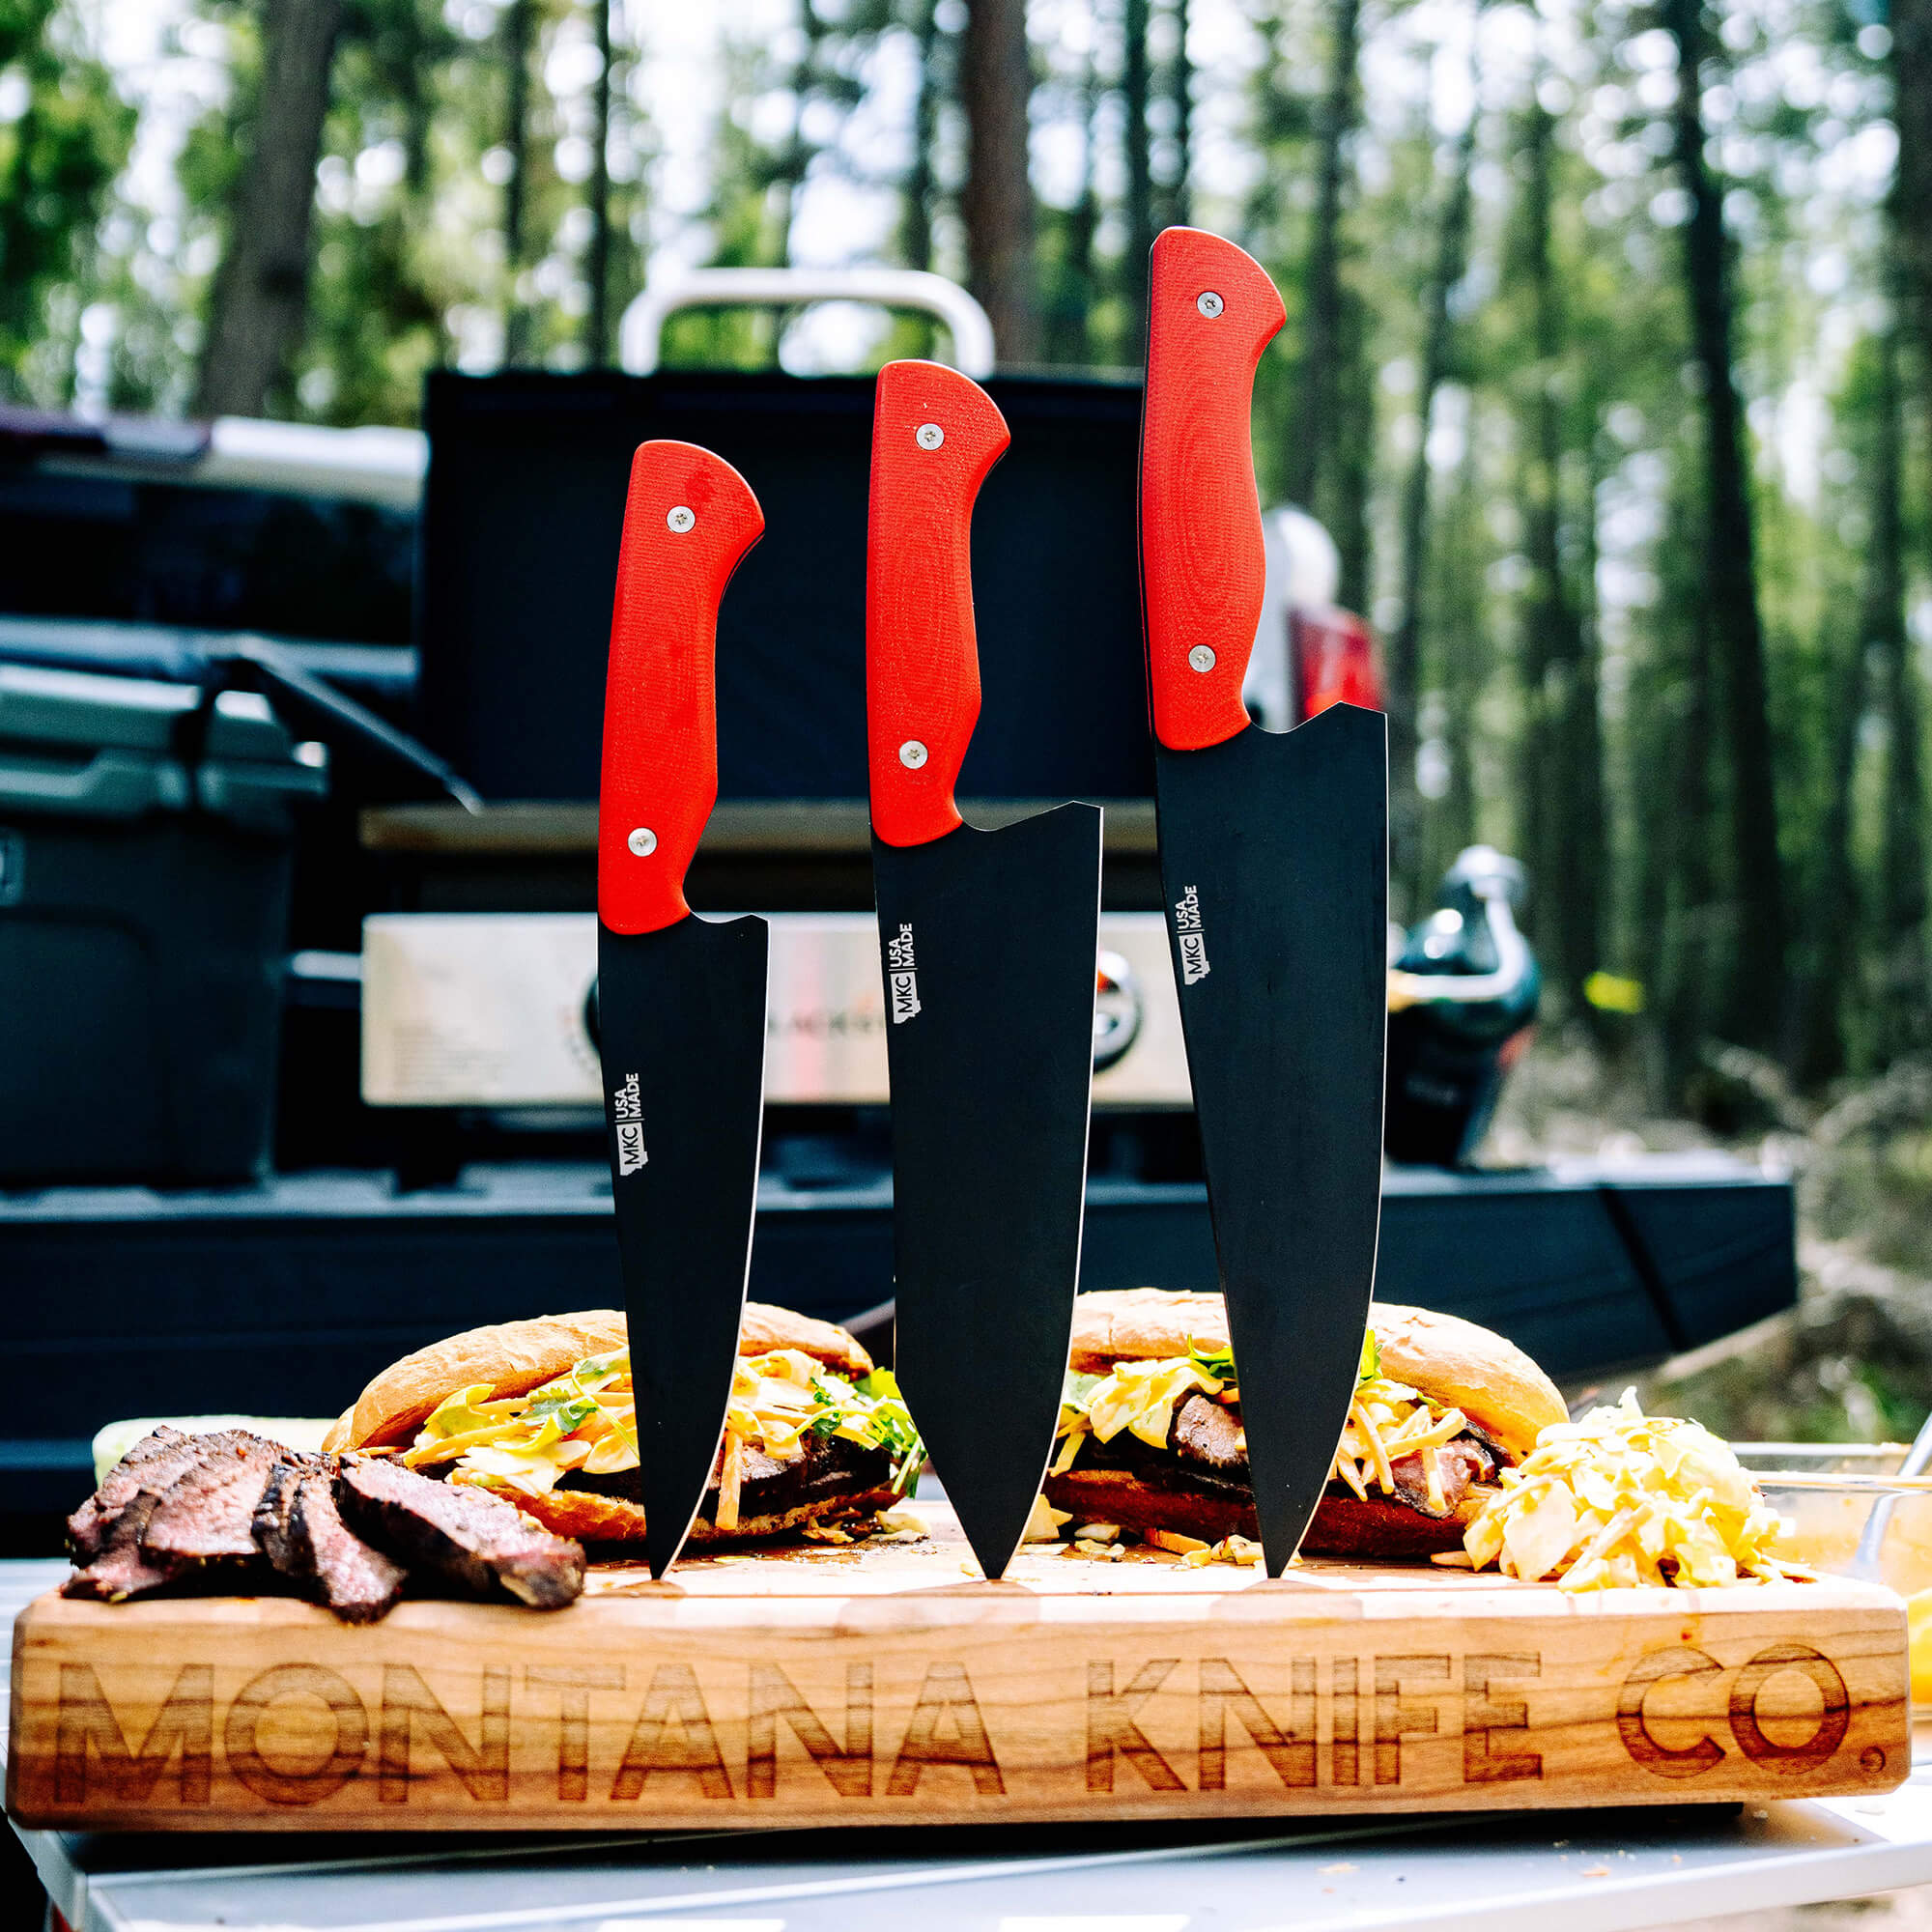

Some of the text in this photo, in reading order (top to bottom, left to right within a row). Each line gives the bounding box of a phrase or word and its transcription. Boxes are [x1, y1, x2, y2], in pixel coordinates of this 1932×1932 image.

[1175, 899, 1190, 929] USA
[1184, 885, 1202, 928] MADE
[889, 937, 903, 967] USA
[899, 923, 915, 967] MADE
[1184, 937, 1203, 974] MKC
[895, 976, 914, 1013] MKC
[614, 1088, 629, 1119] USA
[625, 1072, 641, 1118] MADE
[621, 1126, 640, 1165] MKC
[54, 1642, 1887, 1805] MONTANA KNIFE CO.
